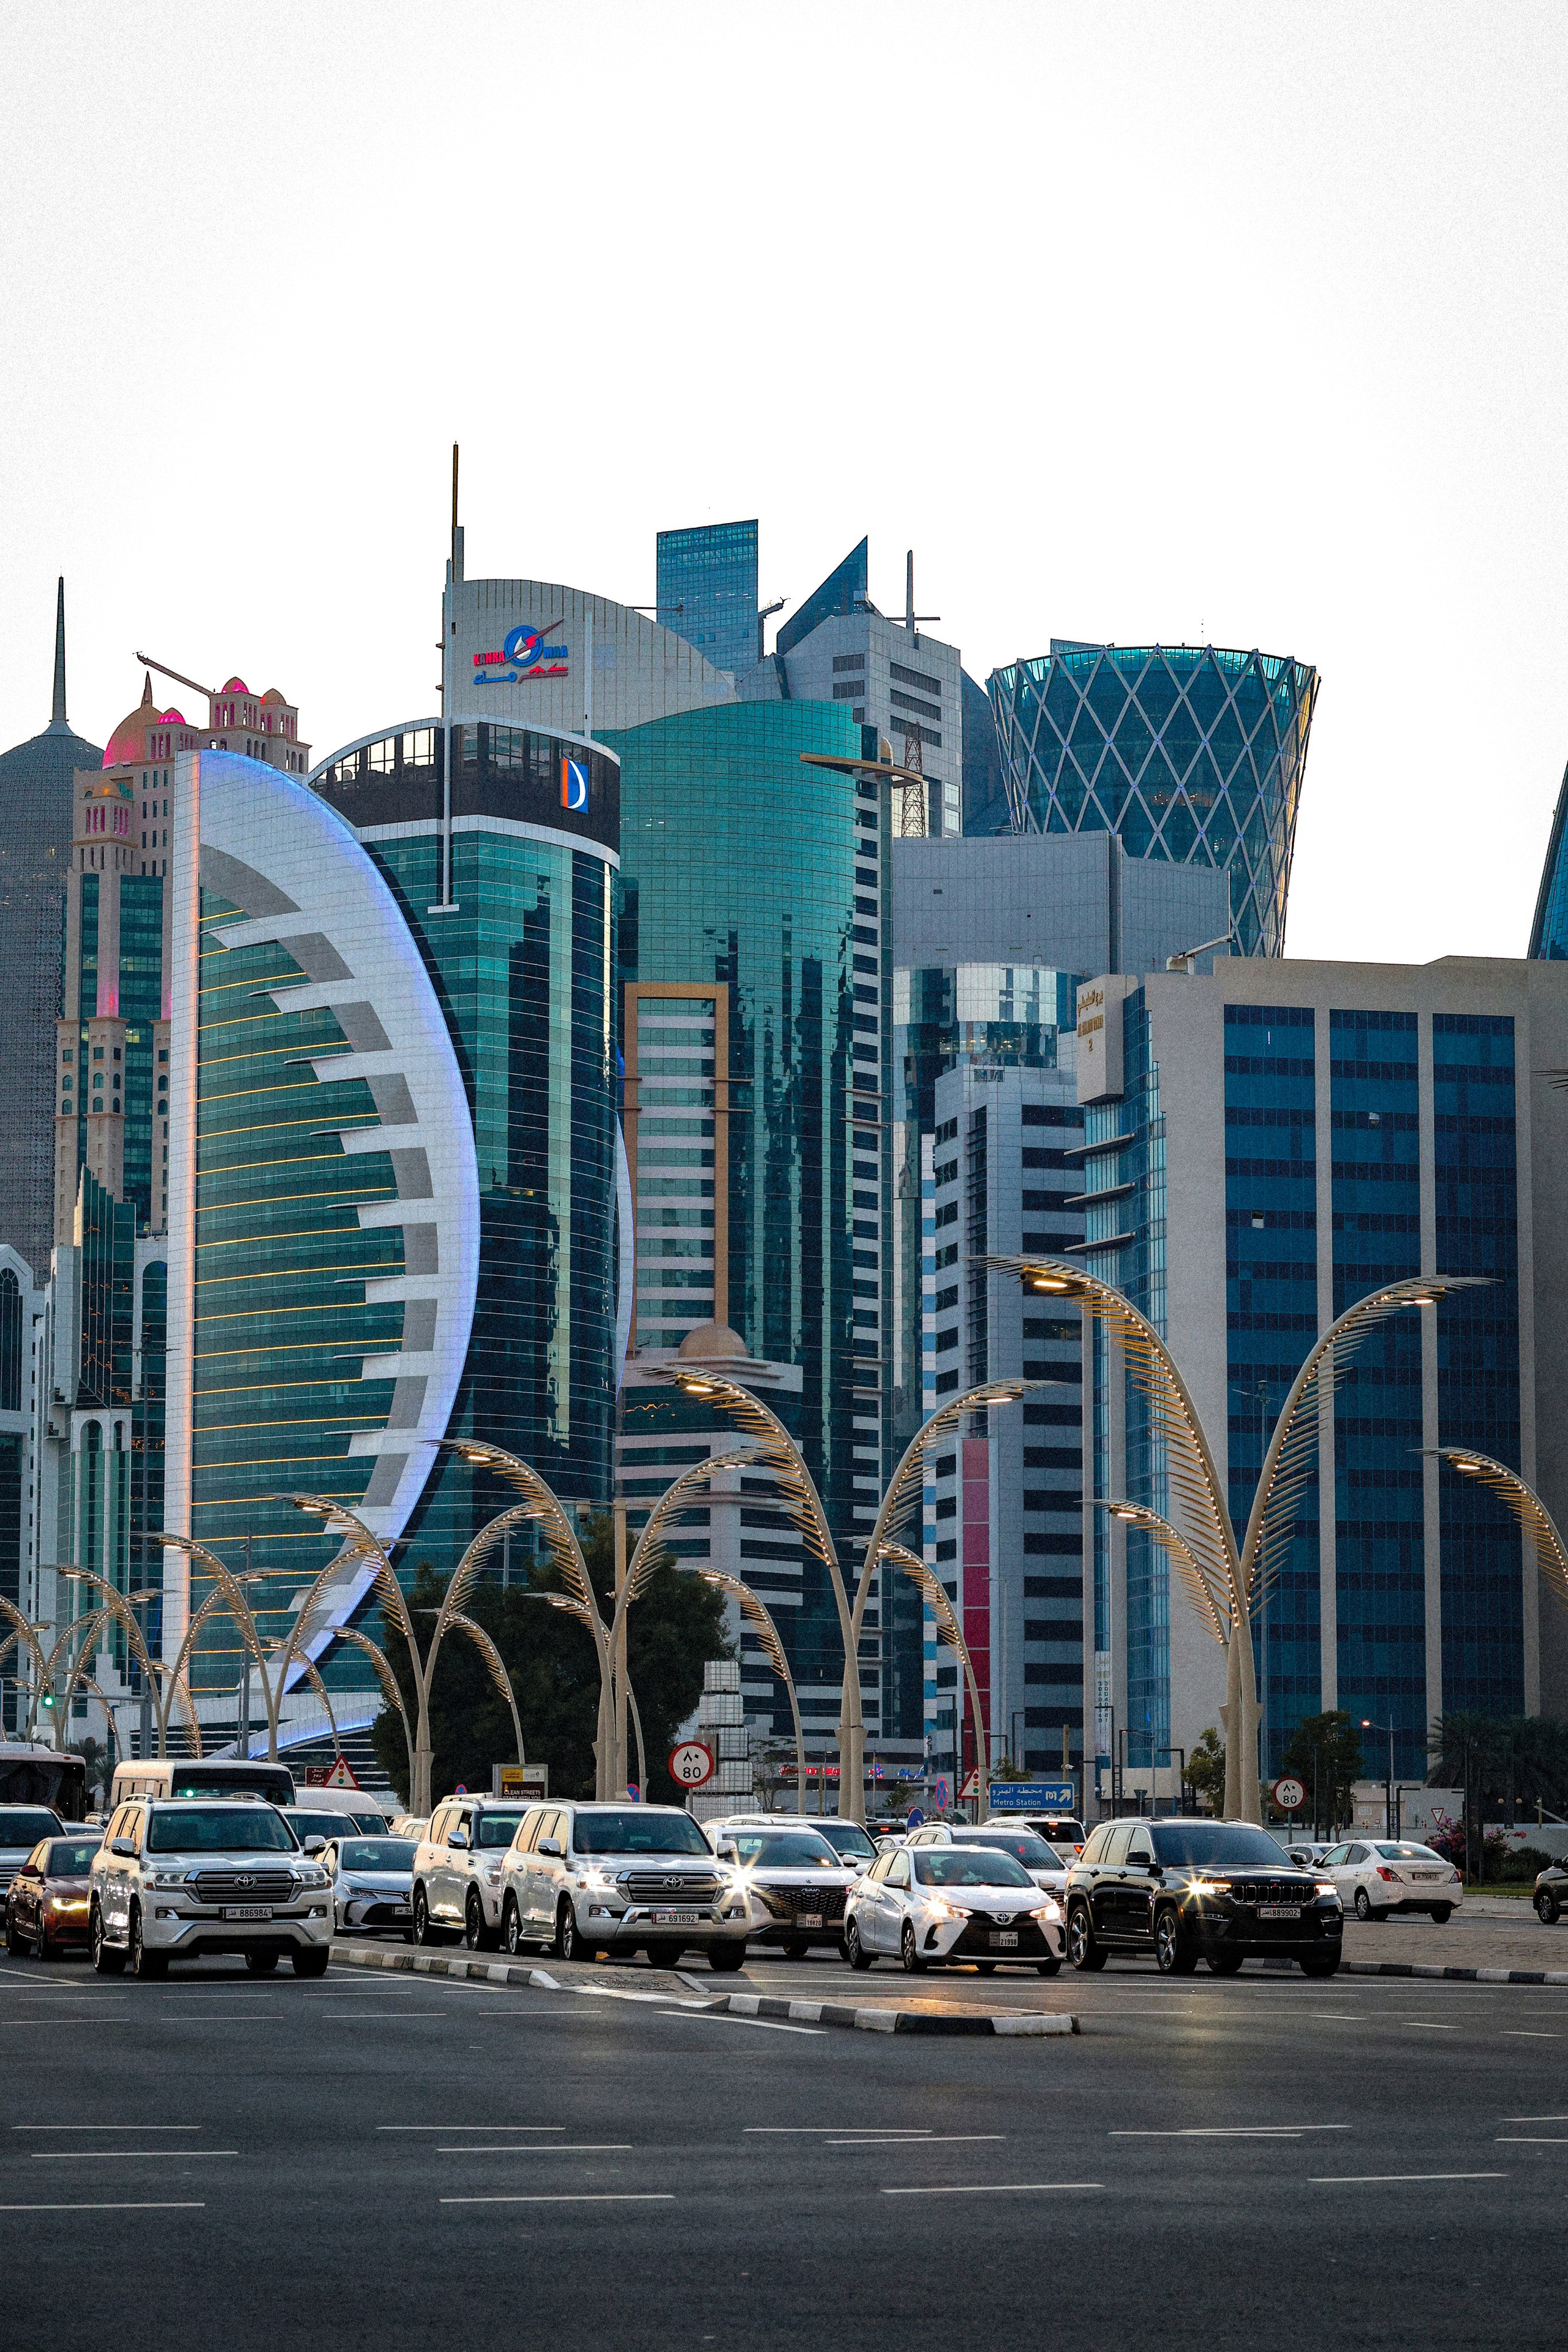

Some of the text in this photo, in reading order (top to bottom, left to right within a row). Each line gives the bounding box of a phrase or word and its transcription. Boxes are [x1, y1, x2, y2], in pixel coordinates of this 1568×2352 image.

[473, 645, 568, 666] KAHRA MAA
[1088, 1038, 1093, 1052] 2
[683, 1766, 701, 1779] 80
[992, 1787, 1014, 1796] المترو
[1283, 1795, 1297, 1804] 80
